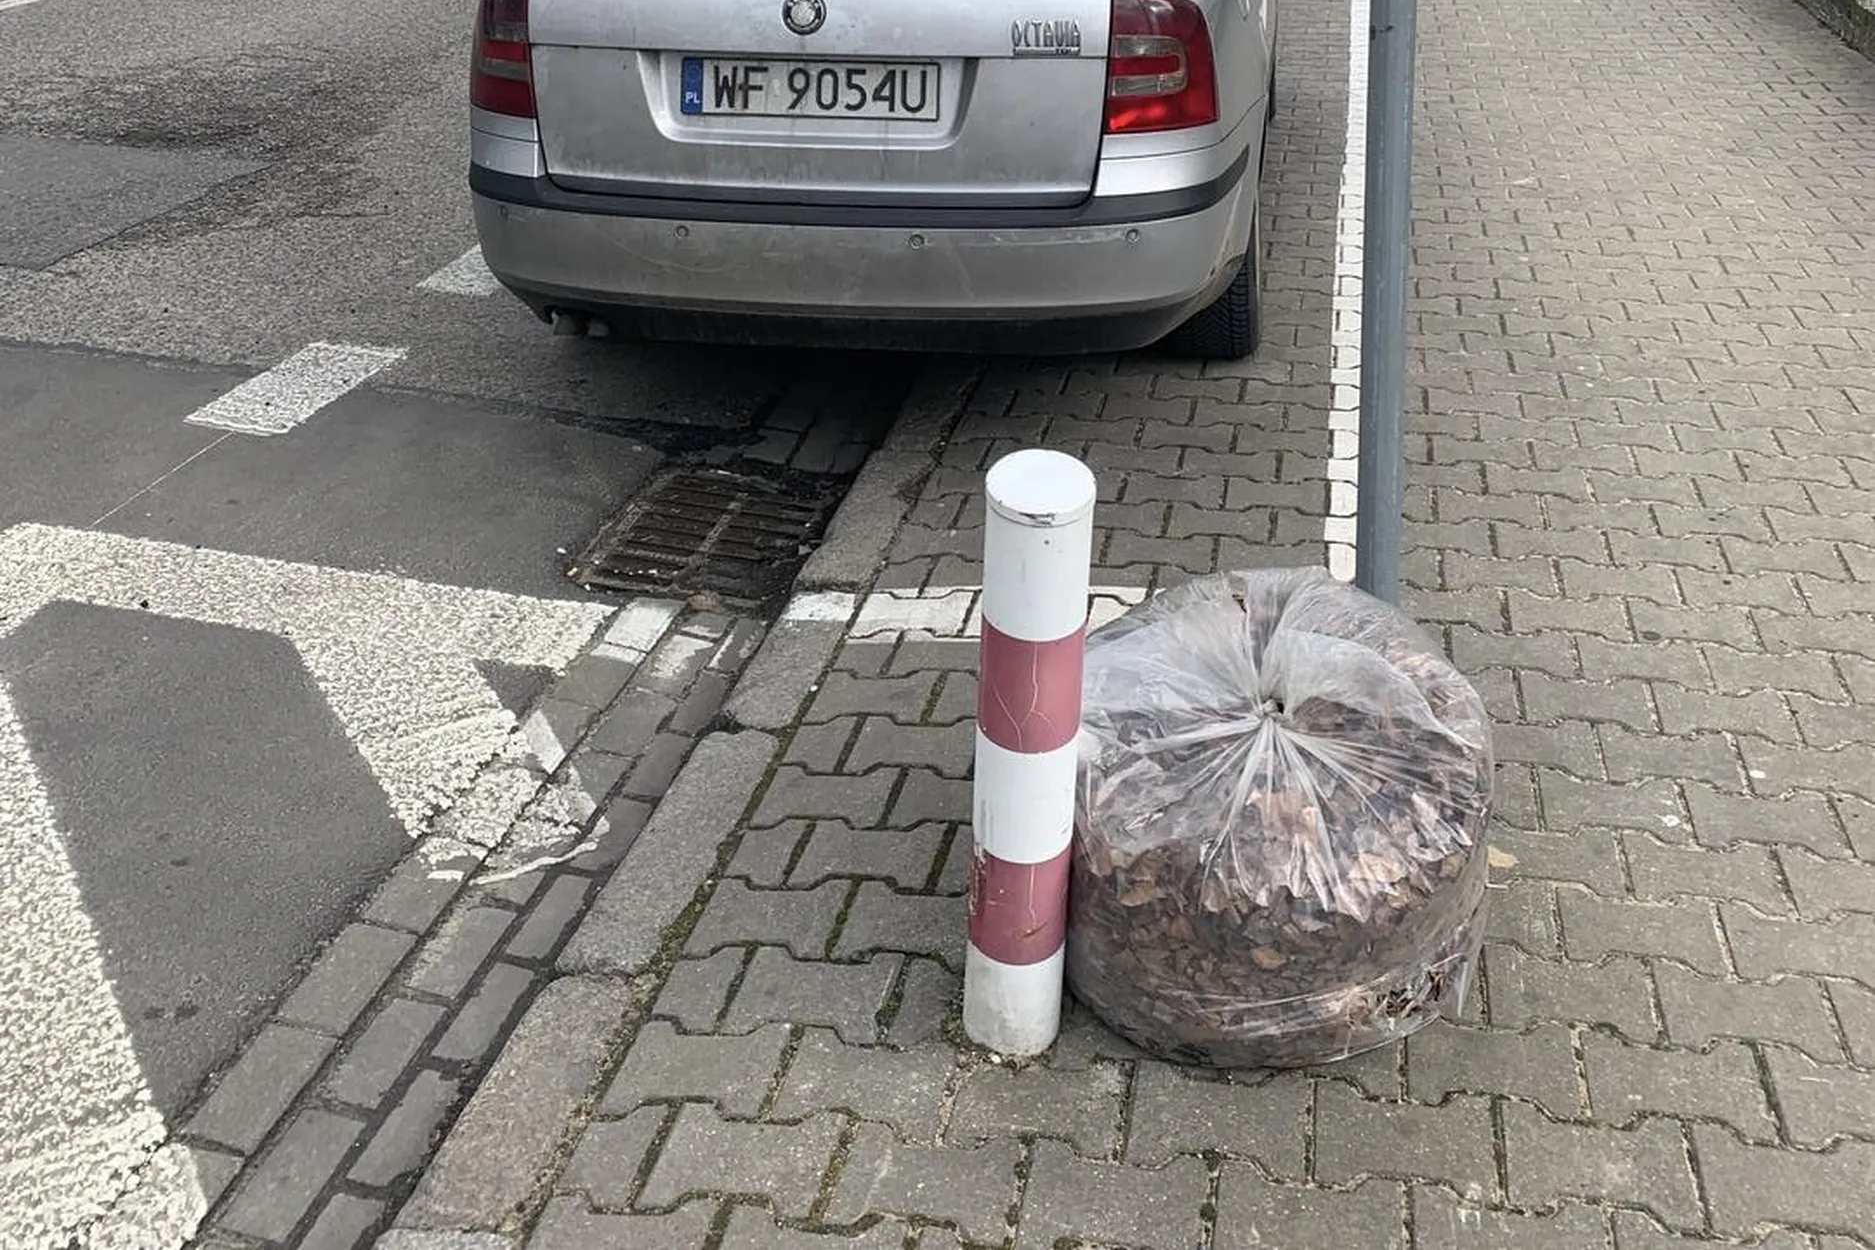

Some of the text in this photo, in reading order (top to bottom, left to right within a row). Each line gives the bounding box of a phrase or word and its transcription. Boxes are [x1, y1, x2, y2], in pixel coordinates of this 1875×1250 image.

[1012, 19, 1080, 47] OCTAVIA
[685, 91, 701, 104] PL
[714, 65, 928, 114] WF 9054U
